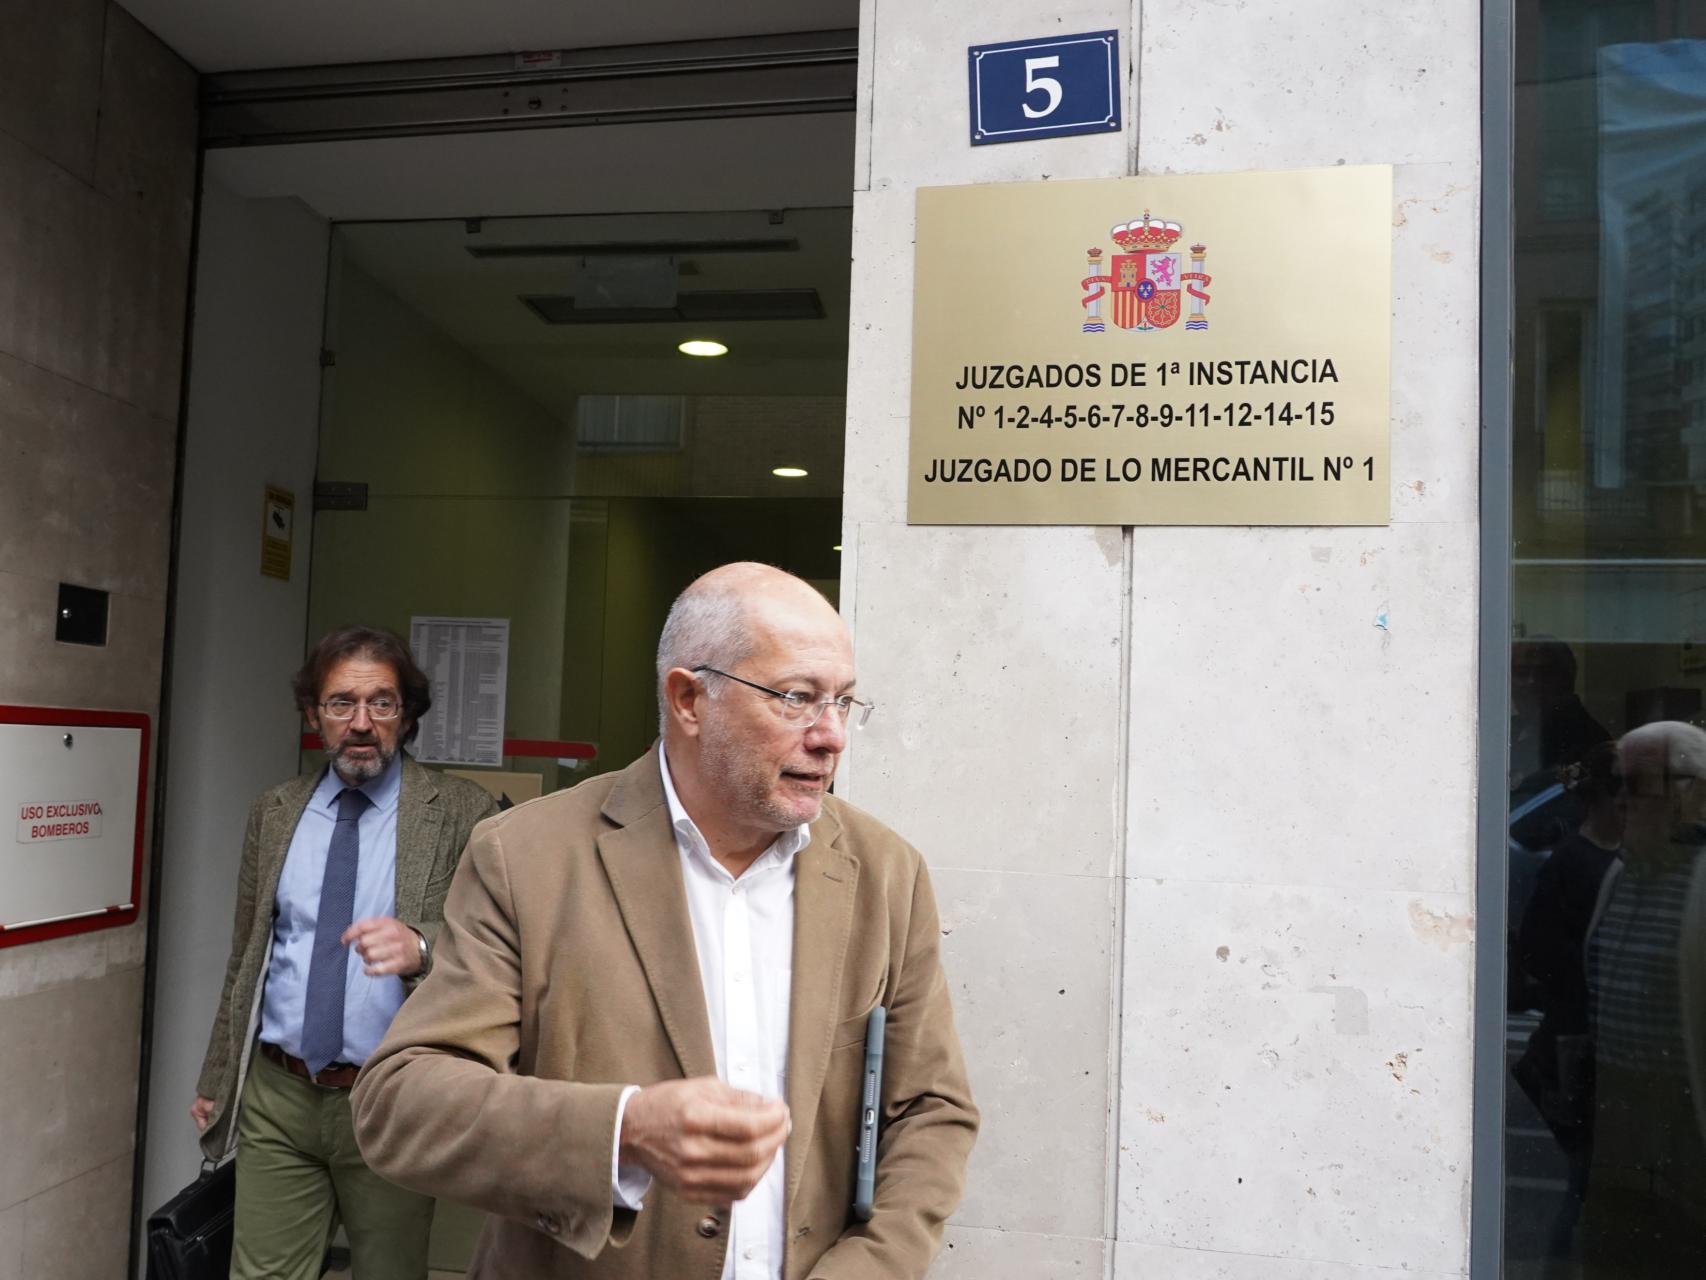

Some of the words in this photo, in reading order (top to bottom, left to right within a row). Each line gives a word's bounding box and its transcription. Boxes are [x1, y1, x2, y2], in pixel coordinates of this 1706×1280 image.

[1022, 55, 1063, 118] 5
[956, 363, 1101, 390] JUZGADOS
[1111, 363, 1147, 387] DE
[1157, 361, 1180, 386] 1ª
[1189, 358, 1339, 386] INSTANCIA
[958, 406, 986, 430] Nº
[994, 401, 1336, 429] 1-2-4-5-6-7-8-9-11-12-14-15
[924, 458, 1052, 483] JUZGADO
[1060, 458, 1096, 482] DE
[1105, 457, 1142, 482] LO
[1151, 456, 1314, 482] MERCANTIL
[1323, 456, 1354, 481] Nº
[1363, 456, 1374, 481] 1
[21, 806, 44, 820] USO
[46, 802, 101, 818] EXCLUSIVO
[31, 821, 90, 838] BOMBEROS
